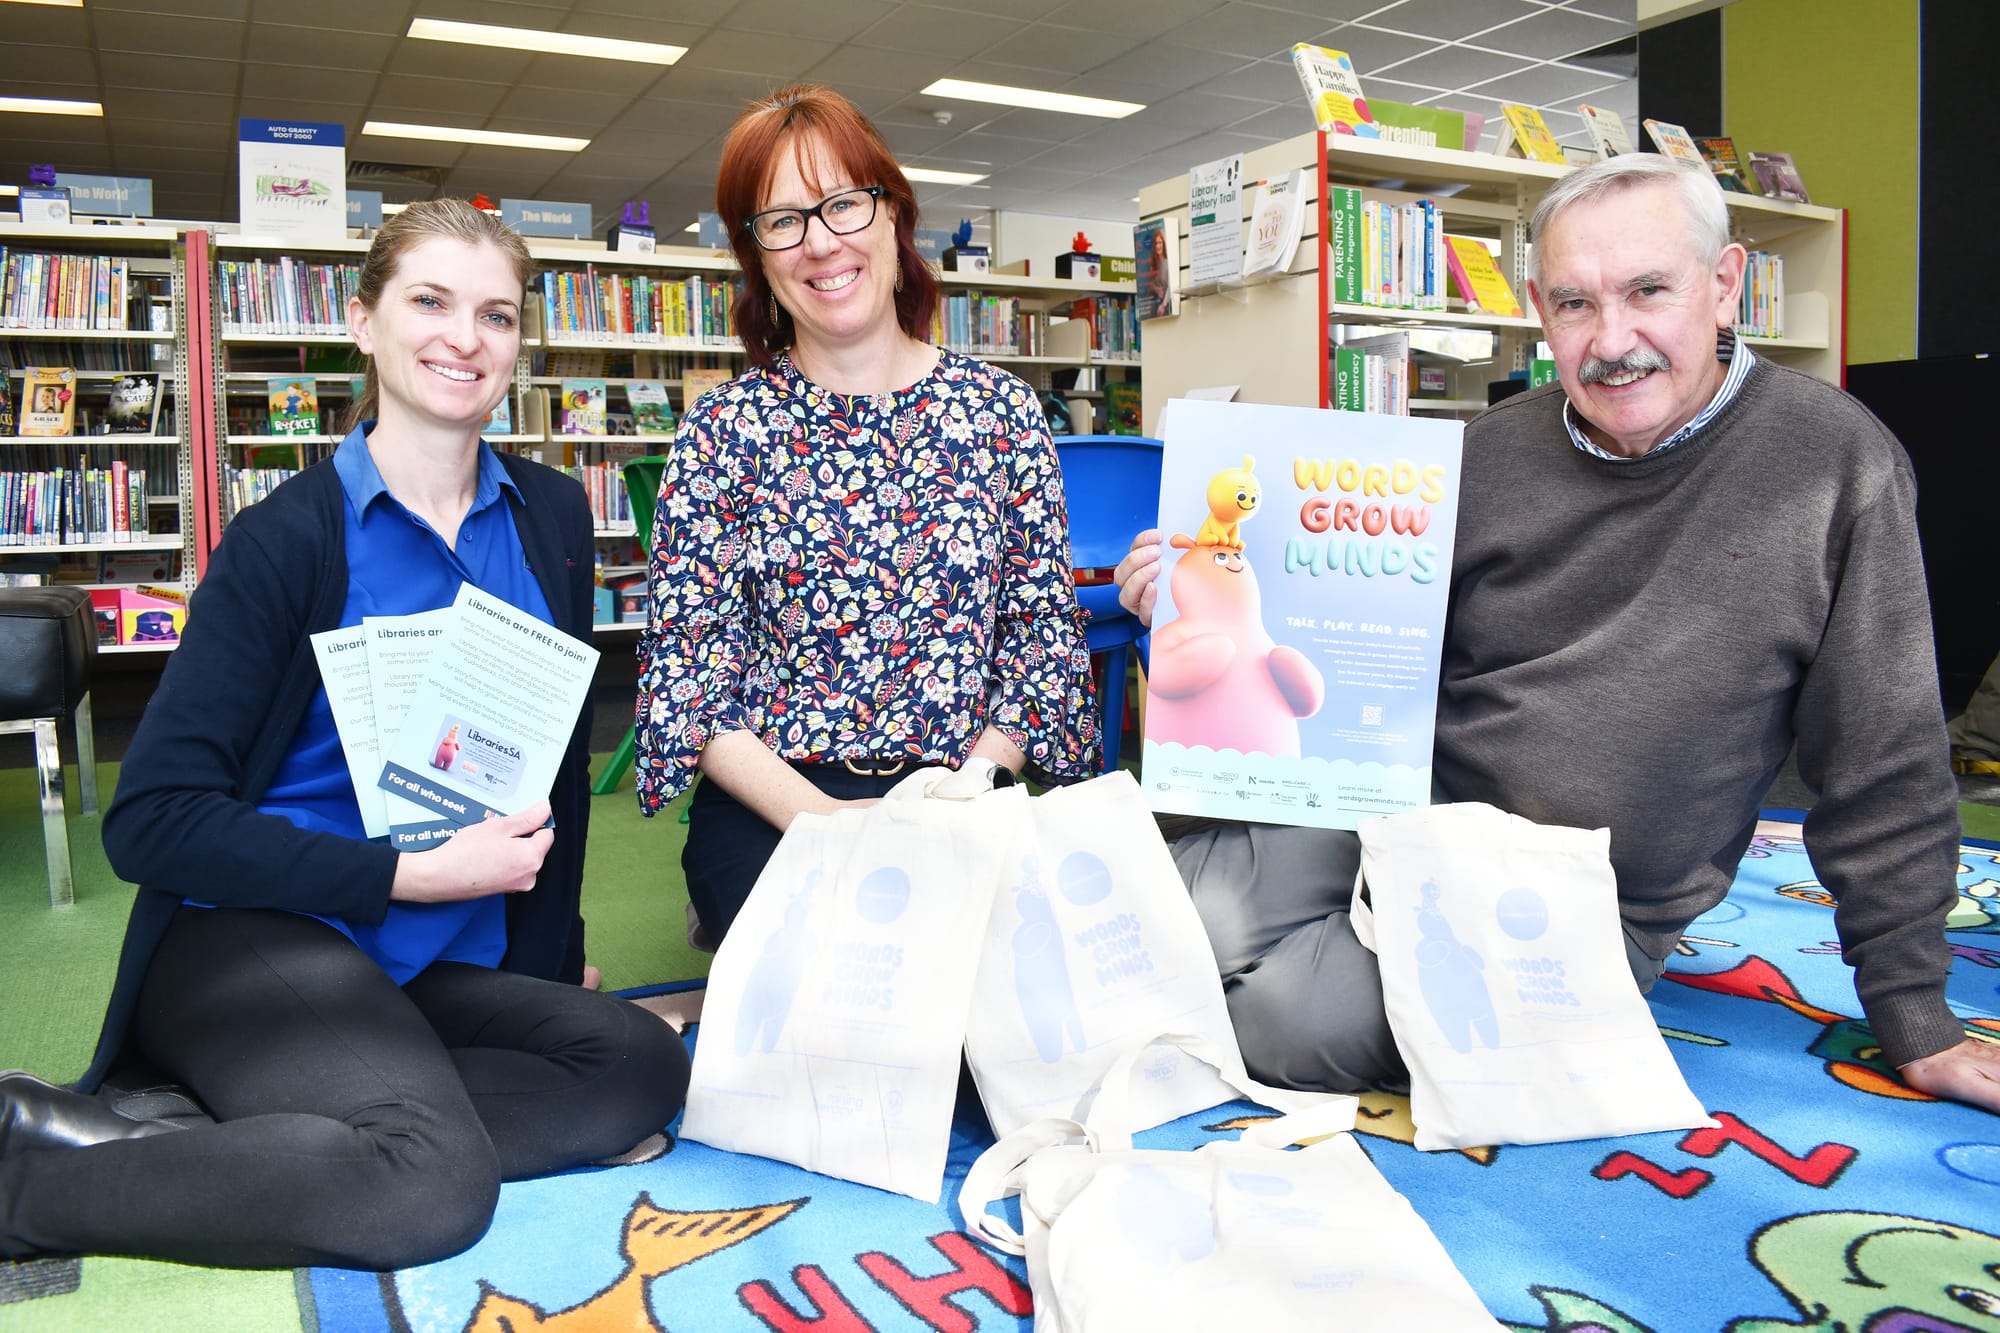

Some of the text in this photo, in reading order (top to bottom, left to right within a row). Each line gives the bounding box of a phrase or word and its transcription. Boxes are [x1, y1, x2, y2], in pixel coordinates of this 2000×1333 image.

[1313, 64, 1345, 80] Happy
[1318, 78, 1360, 95] Families
[70, 186, 90, 198] The
[92, 187, 128, 200] World
[1192, 184, 1218, 198] Library
[1192, 191, 1236, 211] History Trail
[522, 210, 572, 224] The World
[1335, 209, 1344, 278] PARENTING
[1347, 214, 1356, 263] Pregnancy
[1111, 260, 1135, 272] Child
[1347, 264, 1356, 301] Fertility
[1339, 370, 1348, 410] NTING
[274, 416, 317, 430] ROCKET
[1294, 456, 1446, 503] WORDS
[1300, 496, 1432, 536] GROW
[1285, 536, 1439, 584] MINDS
[378, 629, 425, 638] Libraries
[468, 597, 587, 664] Libraries are FREE to join!
[1286, 617, 1318, 629] TALK.
[1324, 620, 1354, 632] PLAY.
[1399, 627, 1430, 638] SING.
[467, 728, 521, 760] LibrariesSA
[388, 772, 467, 814] For all who seek
[399, 828, 455, 843] For all who
[1074, 913, 1141, 948] WORDS
[834, 942, 905, 968] WORDS
[1092, 933, 1141, 964] GROW
[834, 964, 895, 982] GROW
[1095, 950, 1154, 988] MINDS
[1502, 956, 1566, 978] WORDS
[1516, 974, 1565, 990] GROW
[822, 986, 894, 1010] MINDS
[1516, 988, 1582, 1008] MINDS
